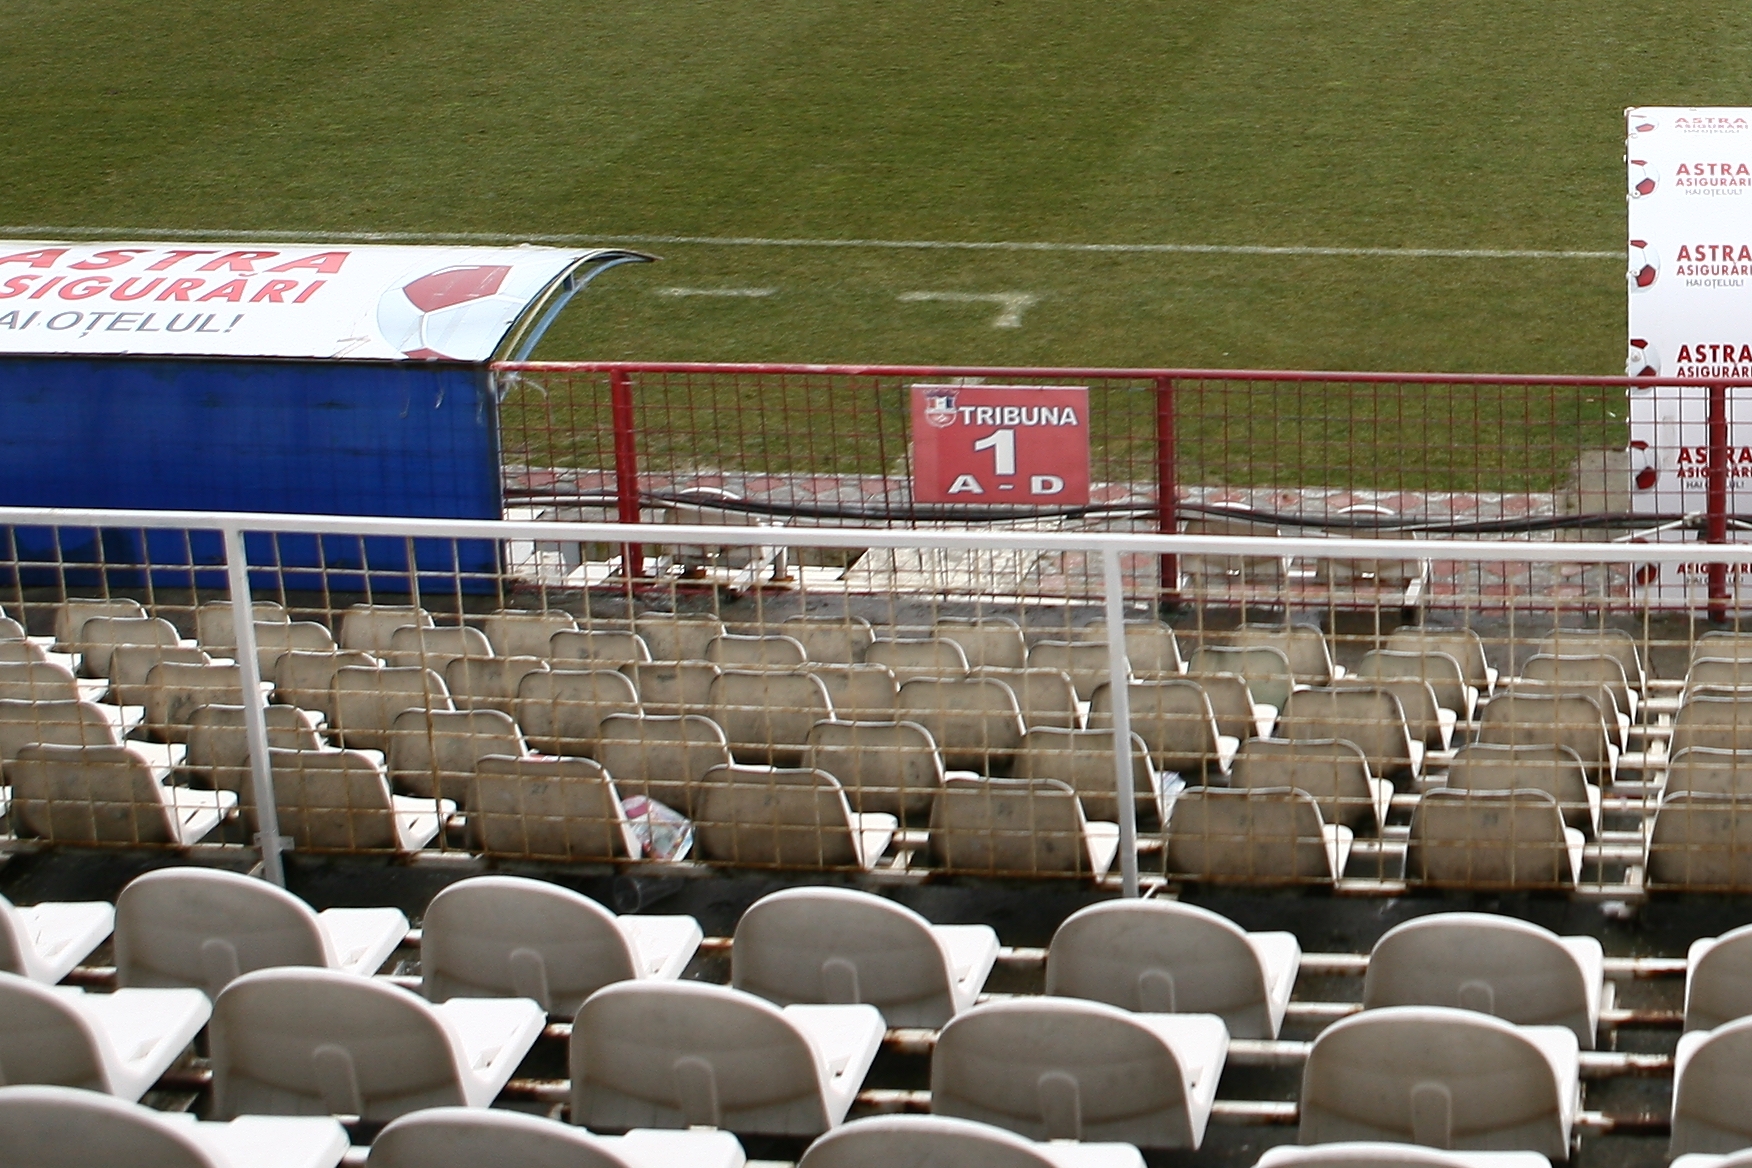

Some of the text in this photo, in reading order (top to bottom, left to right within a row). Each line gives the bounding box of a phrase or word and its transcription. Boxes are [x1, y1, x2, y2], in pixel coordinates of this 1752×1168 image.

[1676, 163, 1751, 176] ASTRA
[0, 248, 352, 274] ASTRA
[1676, 244, 1752, 262] ASTRA
[0, 273, 328, 304] SIGURĂRI
[1686, 279, 1703, 287] HAI
[0, 310, 245, 338] AI OȚELUL!
[959, 406, 1079, 426] TRIBUNA
[974, 428, 1016, 476] 1
[948, 474, 984, 494] A
[1030, 475, 1065, 495] D
